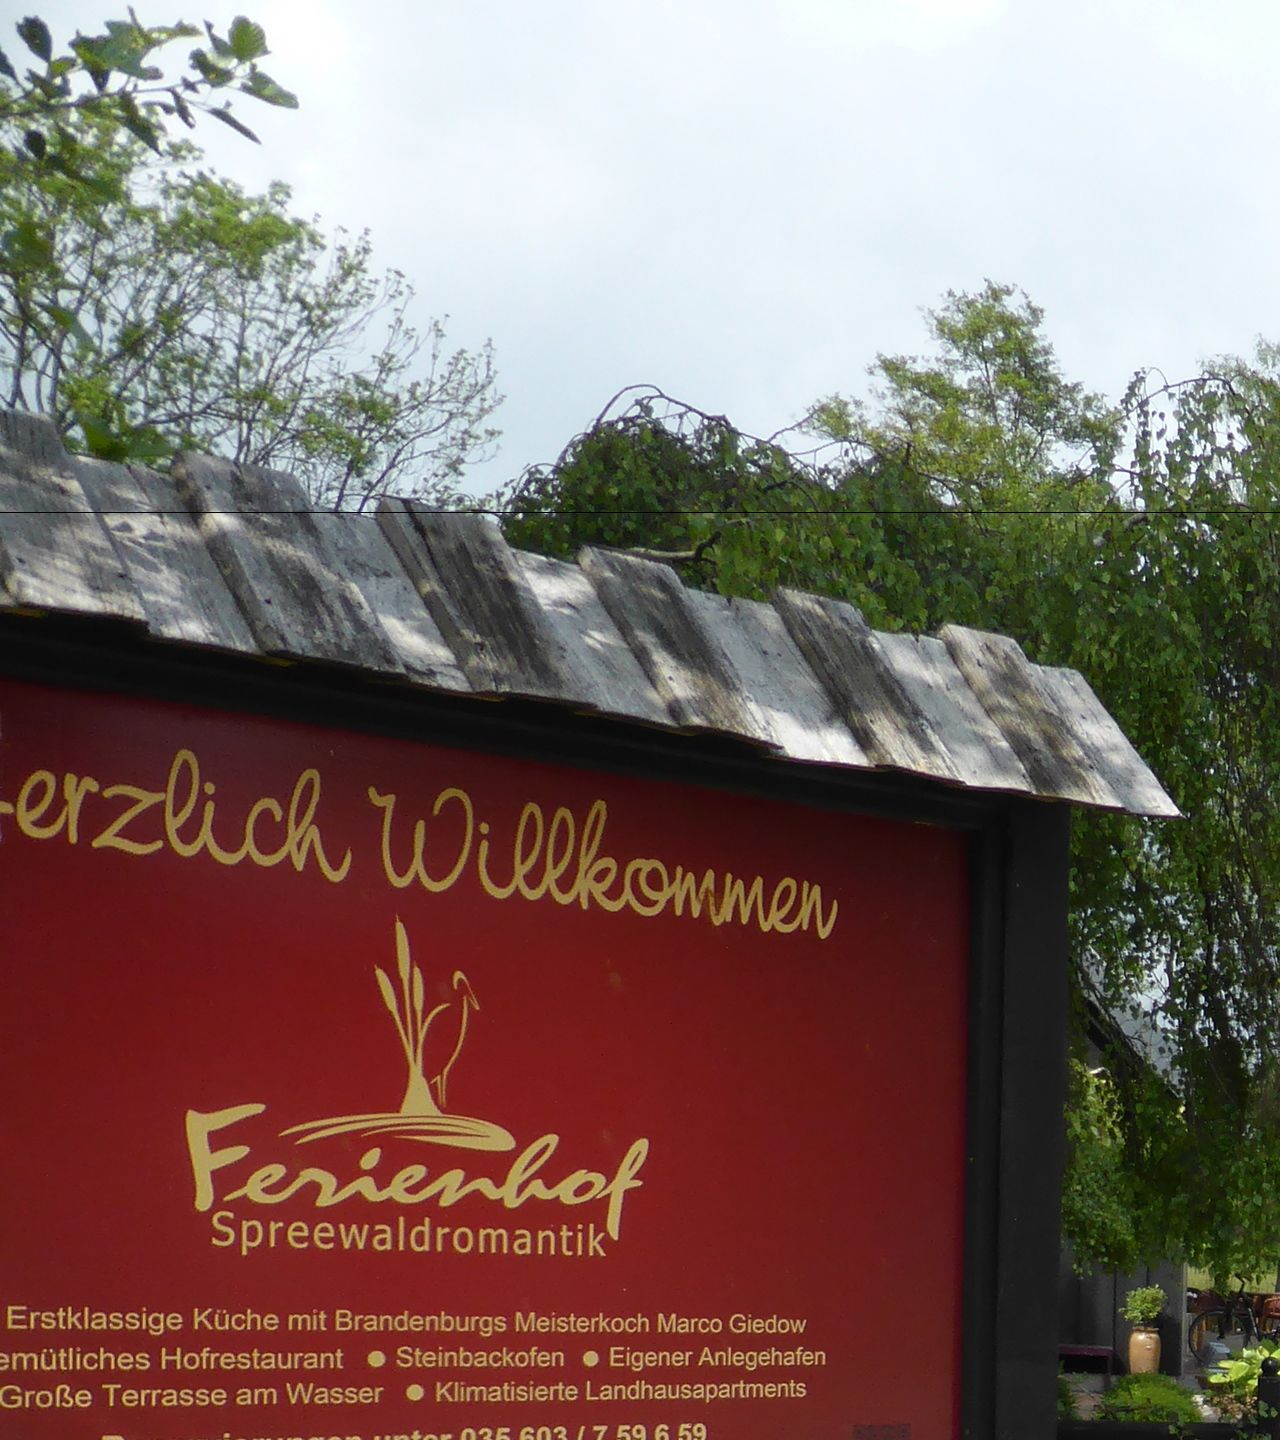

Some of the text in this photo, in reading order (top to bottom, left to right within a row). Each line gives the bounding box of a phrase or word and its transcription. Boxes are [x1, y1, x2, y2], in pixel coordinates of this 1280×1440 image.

[0, 749, 838, 940] erzlich Willkommen
[185, 1103, 650, 1240] Ferienhof
[211, 1210, 607, 1258] Spreewaldromantik
[6, 1305, 807, 1337] Erstklassige Küche mit Brandenburgs Meisterkoch Marco Giedow
[161, 1346, 344, 1370] Hofrestaurant
[395, 1346, 565, 1368] Steinbackofen
[609, 1346, 694, 1372] Eigener
[697, 1346, 826, 1371] Anlegehafen
[0, 1379, 807, 1409] Große Terrasse am Wasser Klimatisierte Landhausapartments
